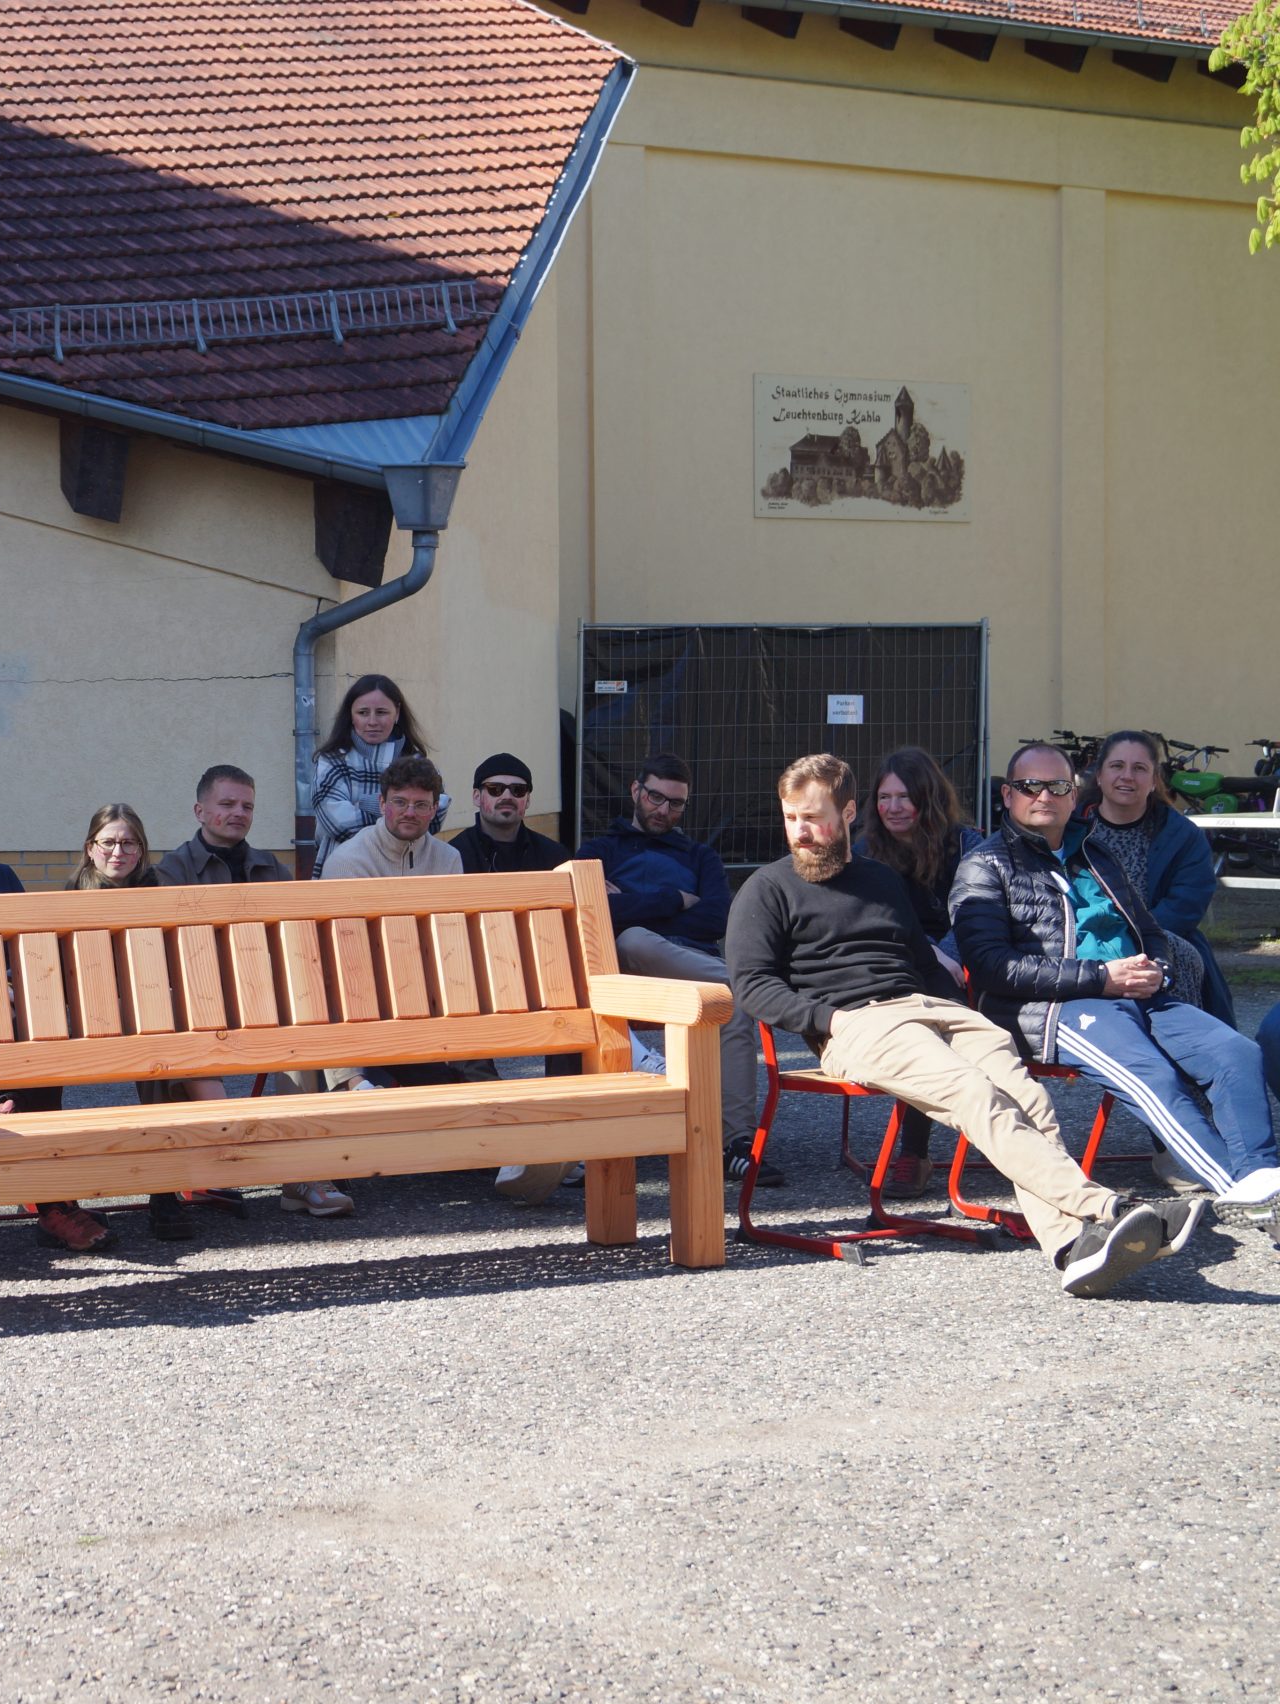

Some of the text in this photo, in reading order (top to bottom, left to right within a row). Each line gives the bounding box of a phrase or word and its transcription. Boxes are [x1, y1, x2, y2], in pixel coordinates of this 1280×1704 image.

[771, 385, 891, 404] Staatliches Gymnasium
[772, 408, 881, 425] Leuchtenburg Kahla
